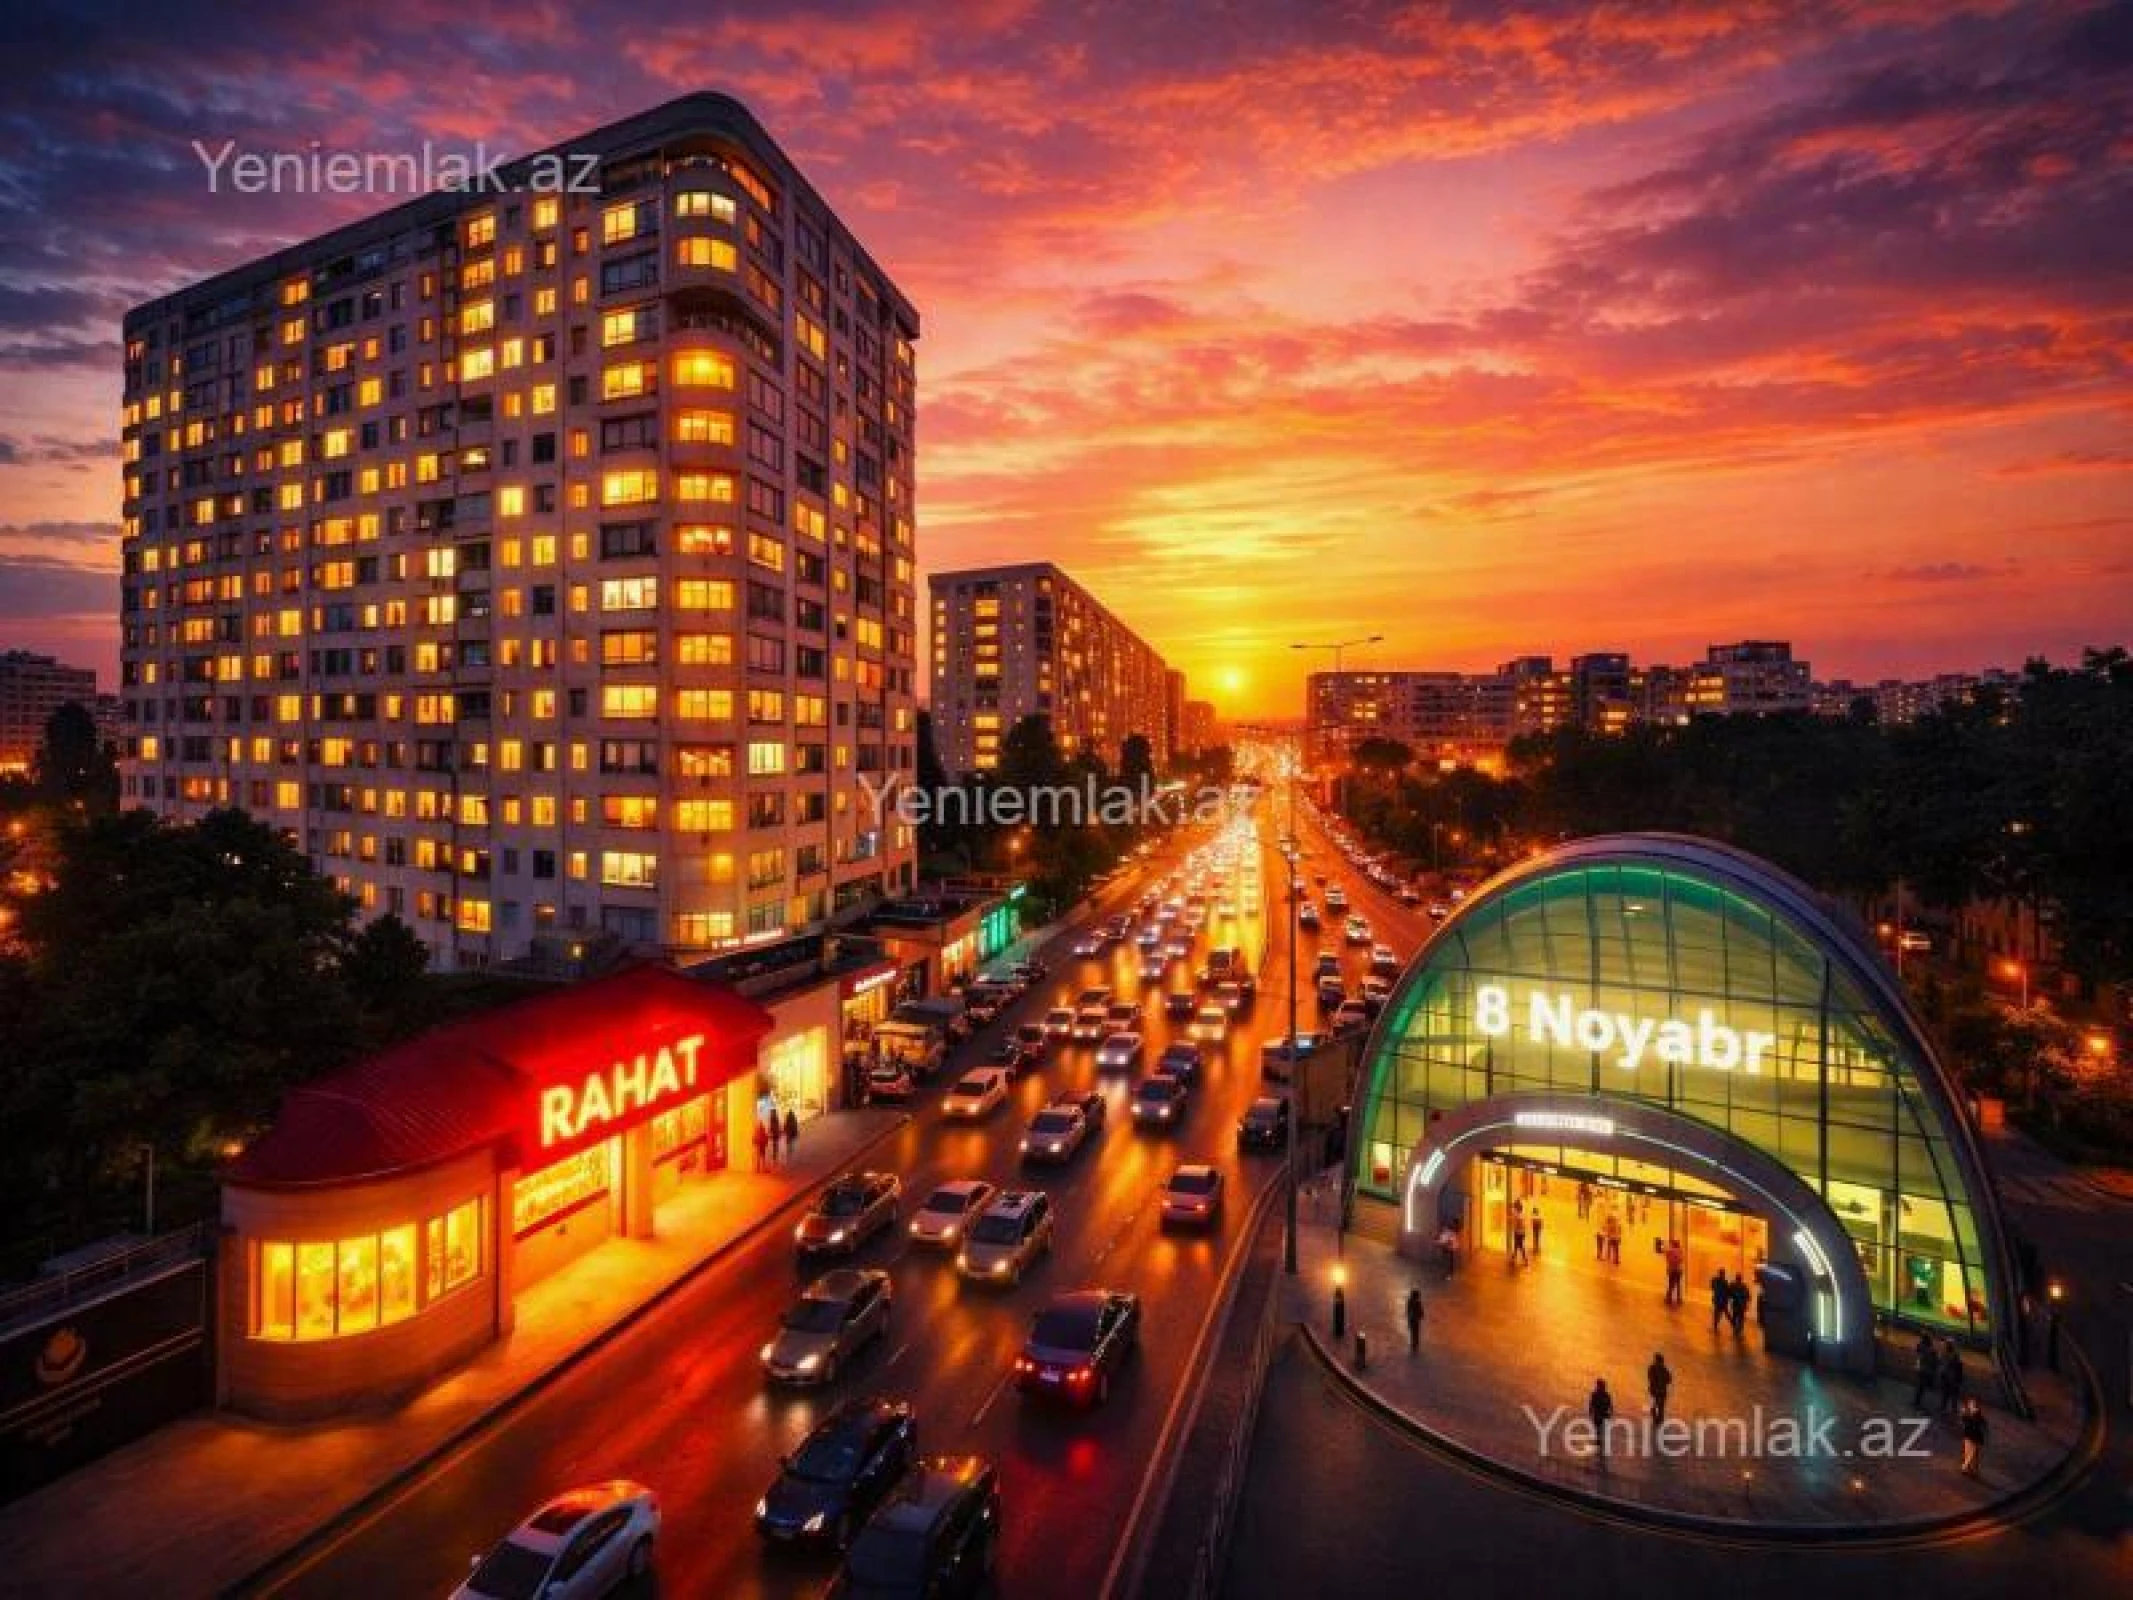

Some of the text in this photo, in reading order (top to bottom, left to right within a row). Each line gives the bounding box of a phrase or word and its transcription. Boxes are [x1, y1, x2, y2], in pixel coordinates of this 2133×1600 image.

[1476, 985, 1775, 1074] 8 Noyabr
[541, 1033, 705, 1148] RAHAT
